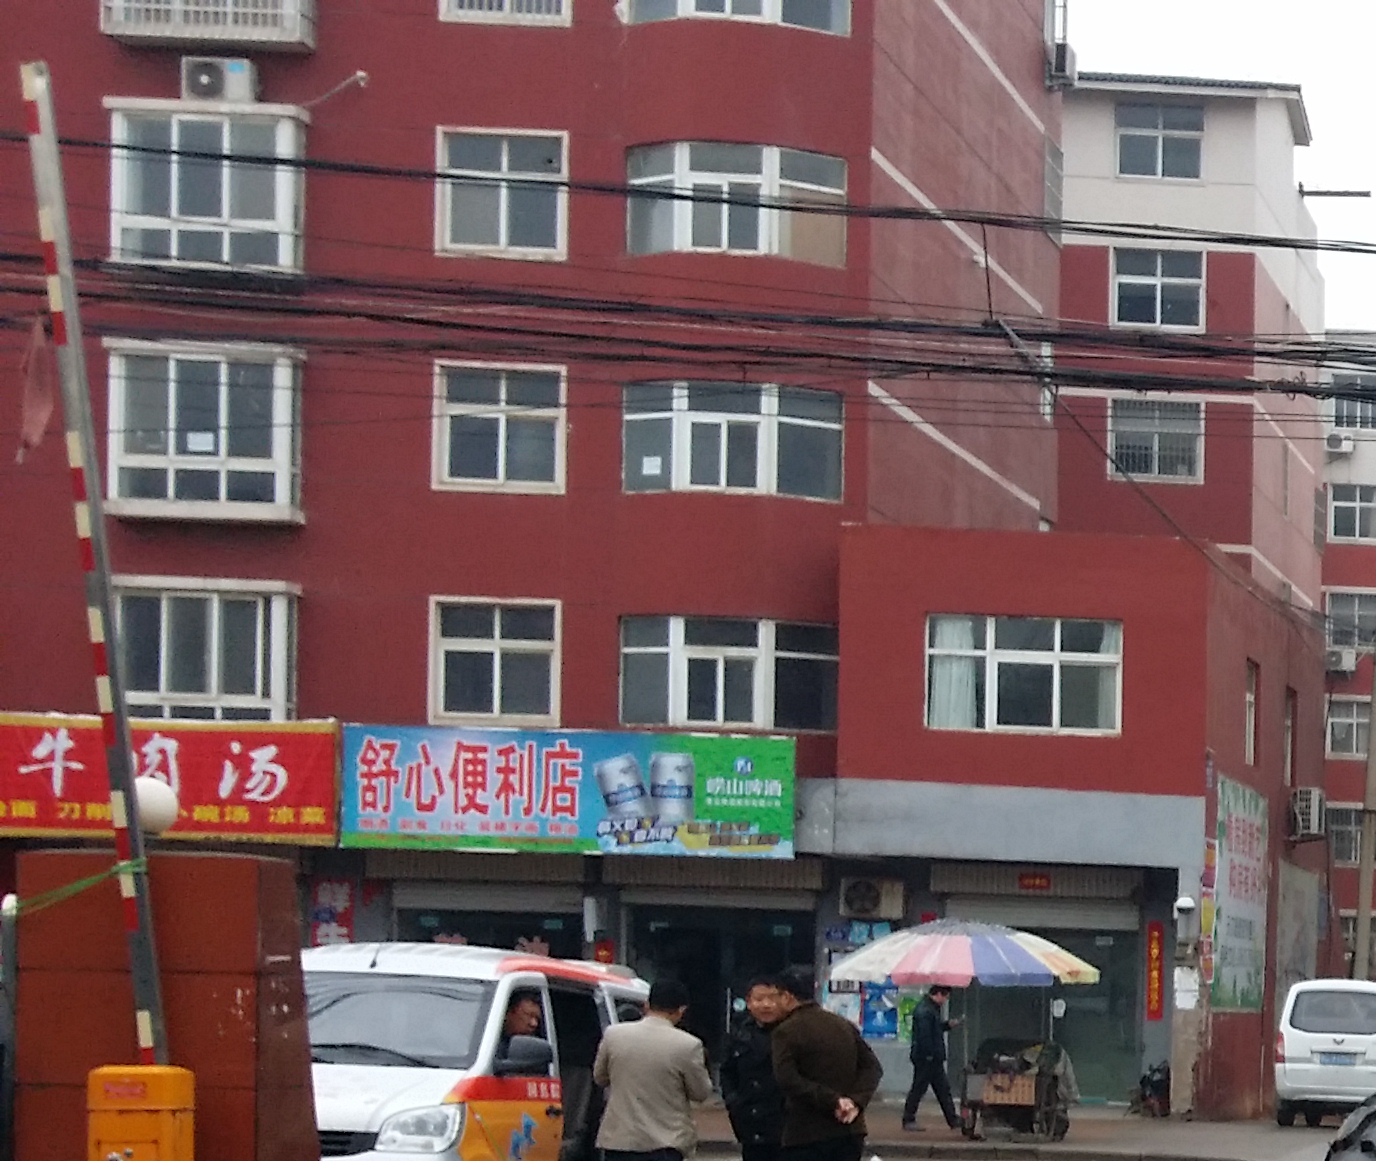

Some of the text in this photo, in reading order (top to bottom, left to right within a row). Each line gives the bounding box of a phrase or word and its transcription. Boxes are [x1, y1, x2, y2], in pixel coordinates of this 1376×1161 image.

[18, 727, 288, 802] 牛肉汤
[358, 736, 581, 819] 舒心便利店
